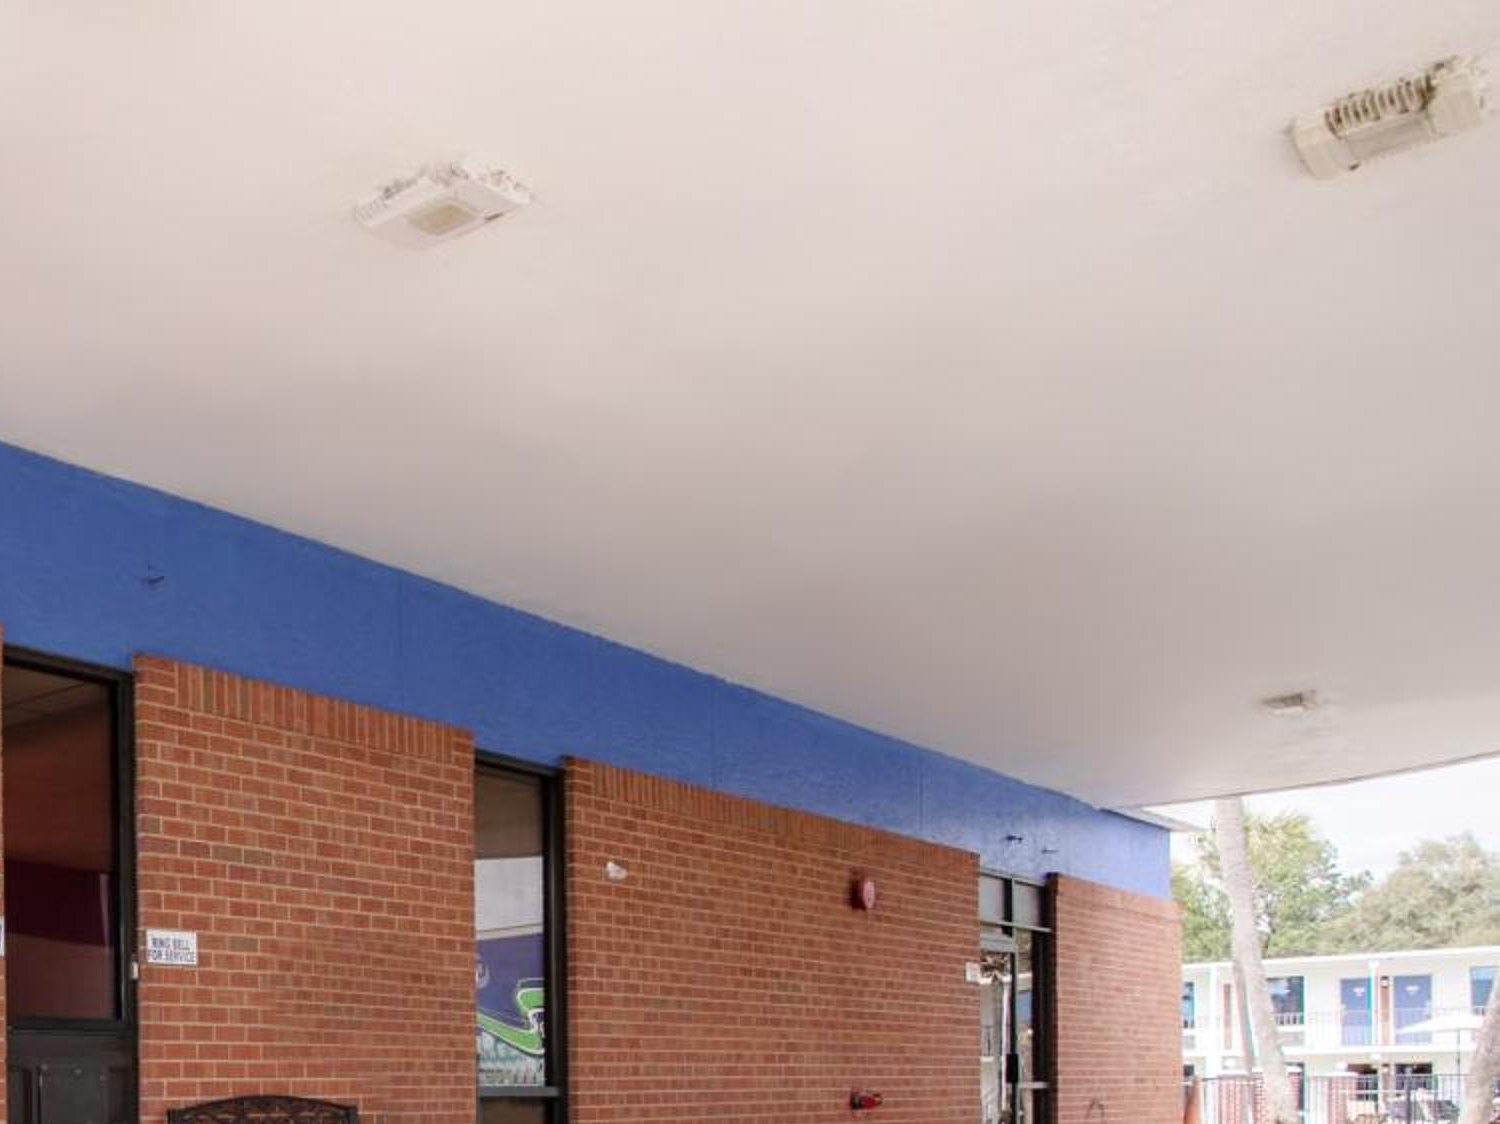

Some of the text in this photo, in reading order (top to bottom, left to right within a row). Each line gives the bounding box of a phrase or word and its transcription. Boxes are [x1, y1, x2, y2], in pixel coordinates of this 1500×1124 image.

[151, 937, 191, 951] RING BELL
[148, 949, 195, 963] FOR SERVICE
